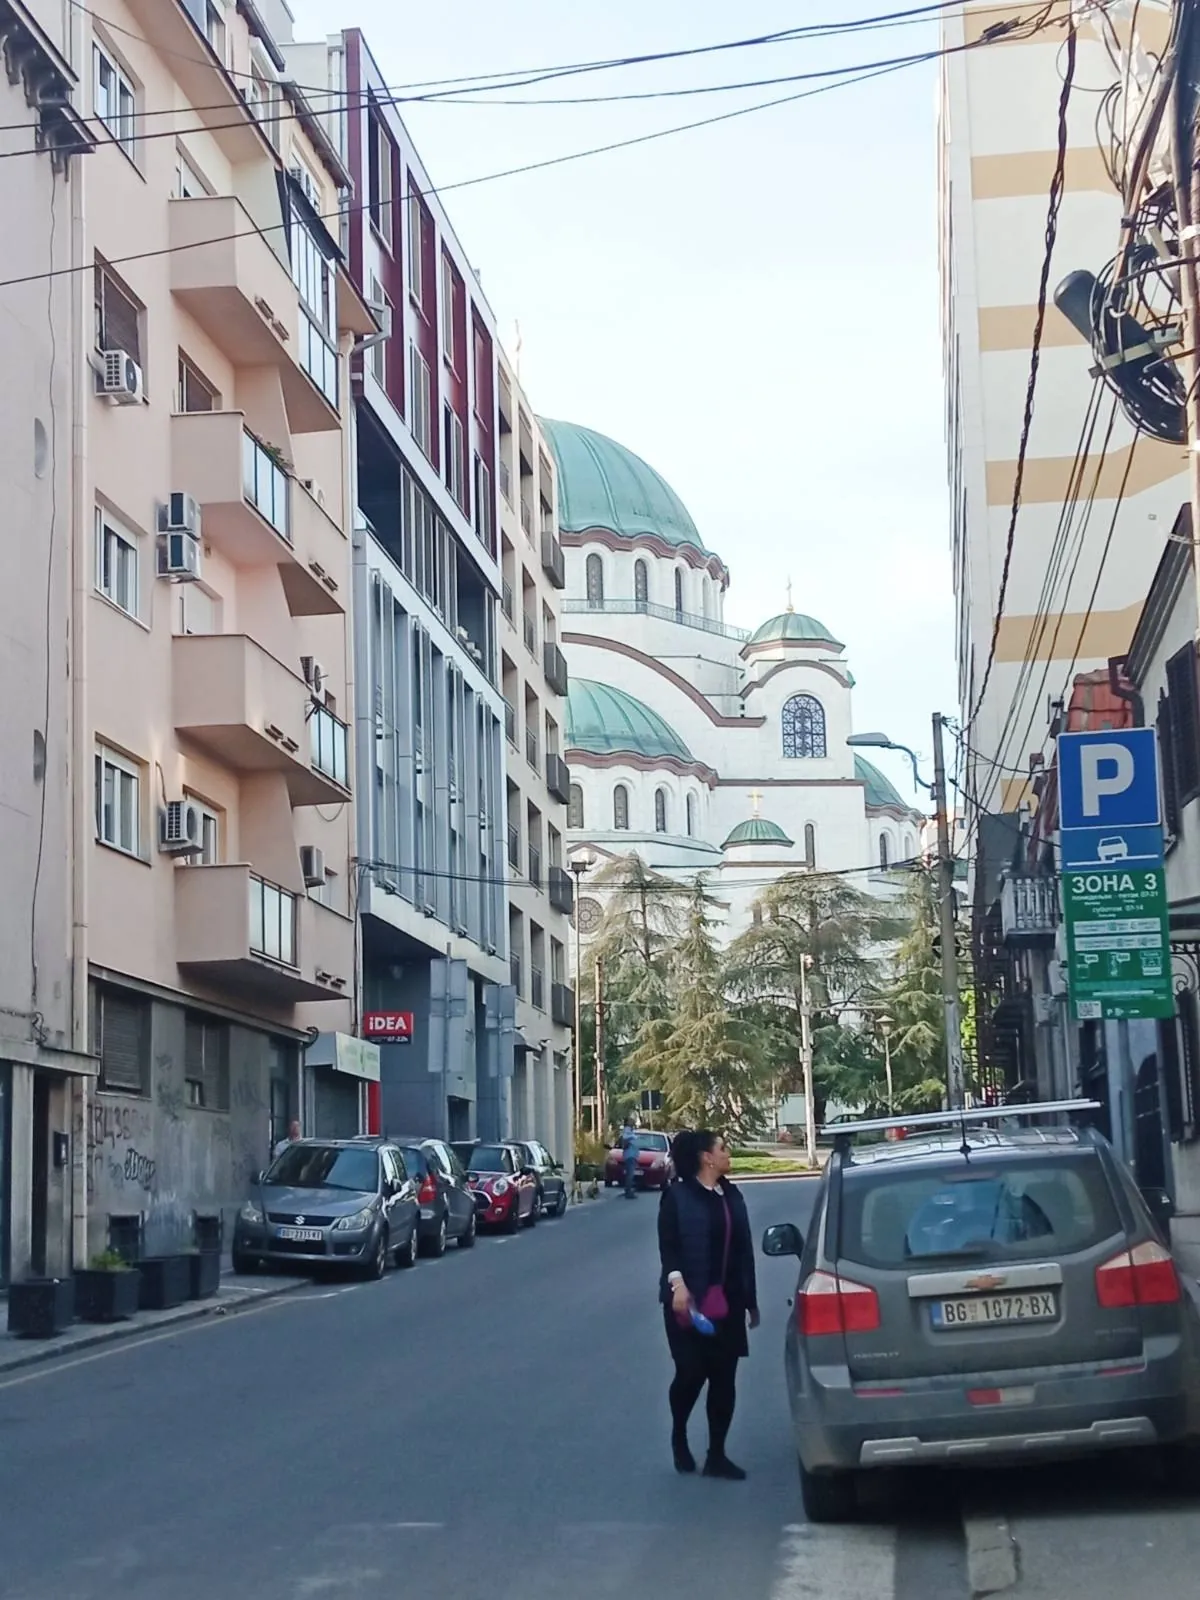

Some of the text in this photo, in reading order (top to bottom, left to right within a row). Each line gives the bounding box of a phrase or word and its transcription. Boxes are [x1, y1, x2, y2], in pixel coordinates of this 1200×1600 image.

[1071, 873, 1157, 894] ЗОНА 3
[944, 1302, 967, 1322] BG
